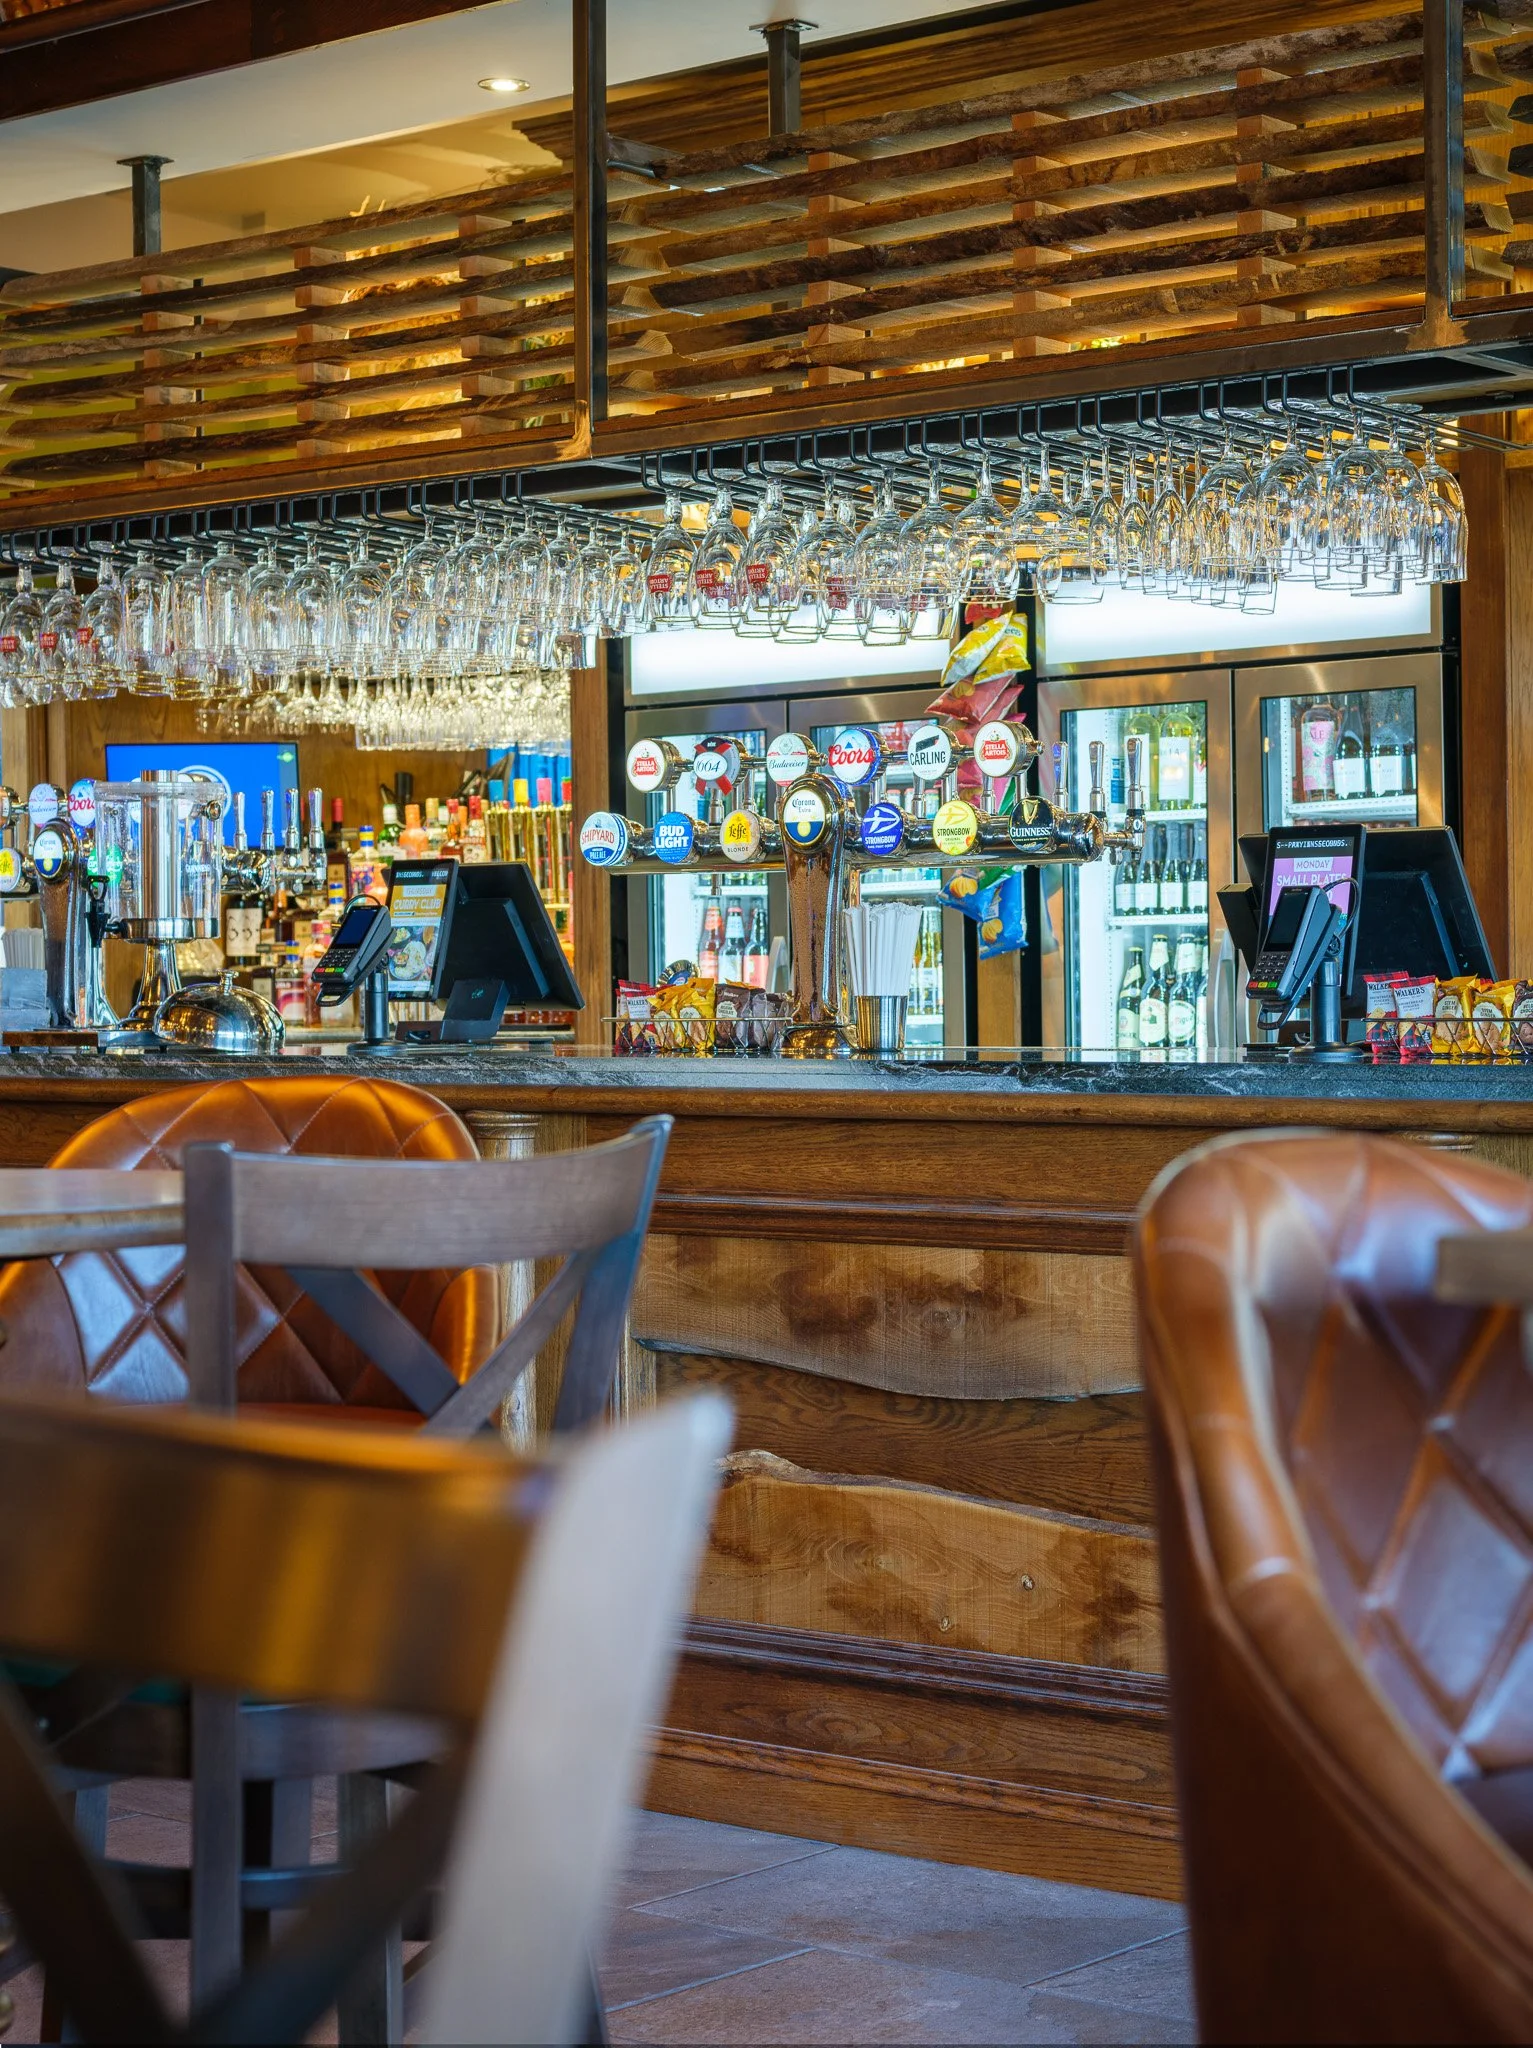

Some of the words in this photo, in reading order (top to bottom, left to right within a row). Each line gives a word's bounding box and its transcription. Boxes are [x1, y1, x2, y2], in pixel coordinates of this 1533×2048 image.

[827, 744, 876, 767] Coors
[909, 751, 946, 766] CARLING
[768, 759, 806, 769] Budweiser
[67, 794, 95, 812] Coor
[792, 798, 816, 808] Corona
[582, 829, 615, 845] SHIPYARD
[659, 825, 685, 837] BUD
[729, 823, 747, 840] Leffe
[937, 827, 971, 837] STRONGBOW
[1010, 826, 1052, 837] GUINNESS
[655, 836, 690, 849] LIGHT
[865, 835, 897, 845] STRONGBOW
[589, 850, 599, 859] PALE
[1296, 859, 1330, 869] MONDAY
[1276, 874, 1309, 886] SMALL
[393, 899, 419, 910] CURRY
[420, 898, 441, 909] CLUB
[1368, 983, 1390, 991] WALKE
